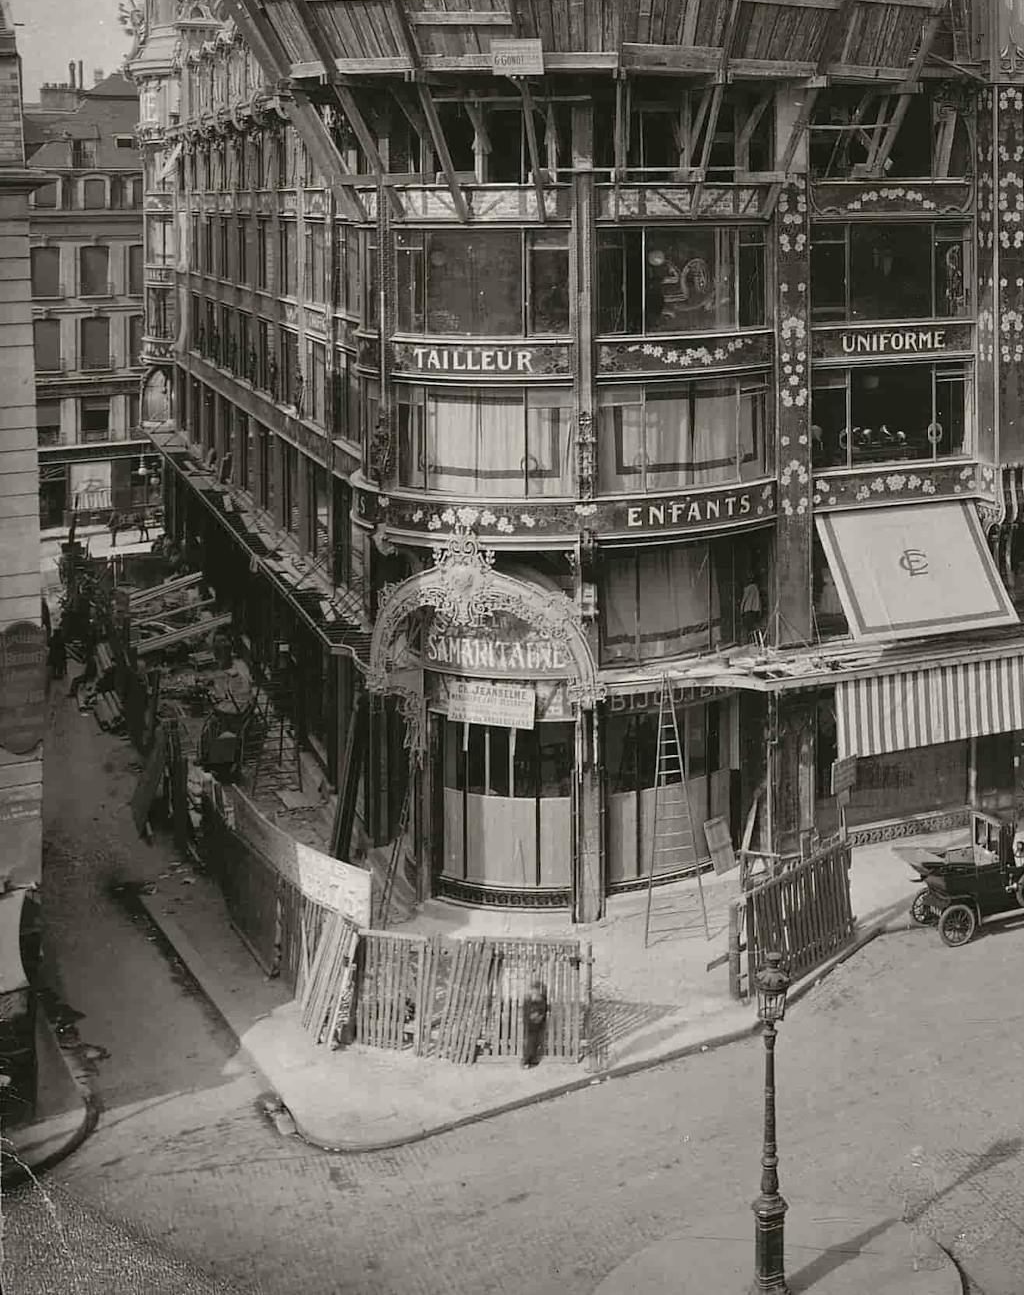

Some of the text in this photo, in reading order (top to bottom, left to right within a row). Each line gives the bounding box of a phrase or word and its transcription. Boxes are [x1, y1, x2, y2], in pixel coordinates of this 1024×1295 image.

[840, 330, 946, 353] UNIFORME
[411, 346, 533, 373] TAILLEUR
[626, 493, 752, 528] ENFANTS
[427, 633, 567, 670] SAMARITAINE
